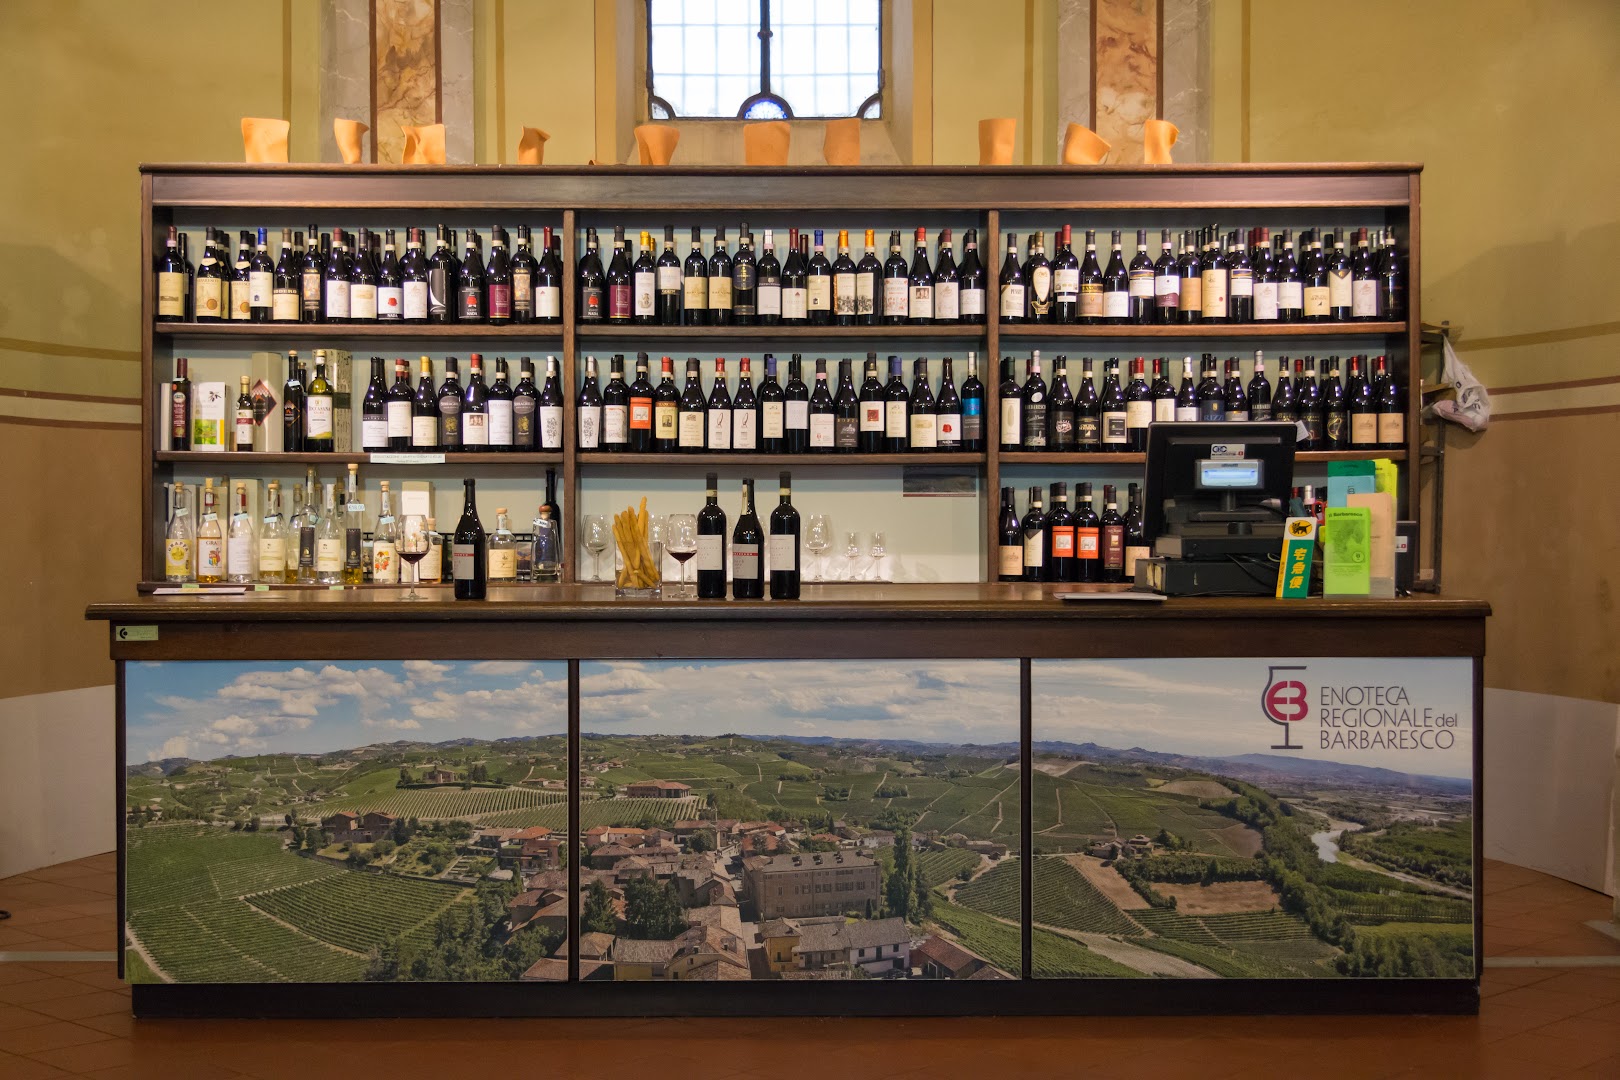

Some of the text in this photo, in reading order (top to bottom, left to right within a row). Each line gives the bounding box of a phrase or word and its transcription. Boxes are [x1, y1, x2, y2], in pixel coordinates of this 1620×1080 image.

[167, 541, 189, 552] GRAPPA
[1289, 547, 1308, 590] 宅急便
[1320, 686, 1410, 706] ENOTECA
[1320, 708, 1458, 728] REGIONALE del
[1320, 729, 1455, 750] BARBARESCO
